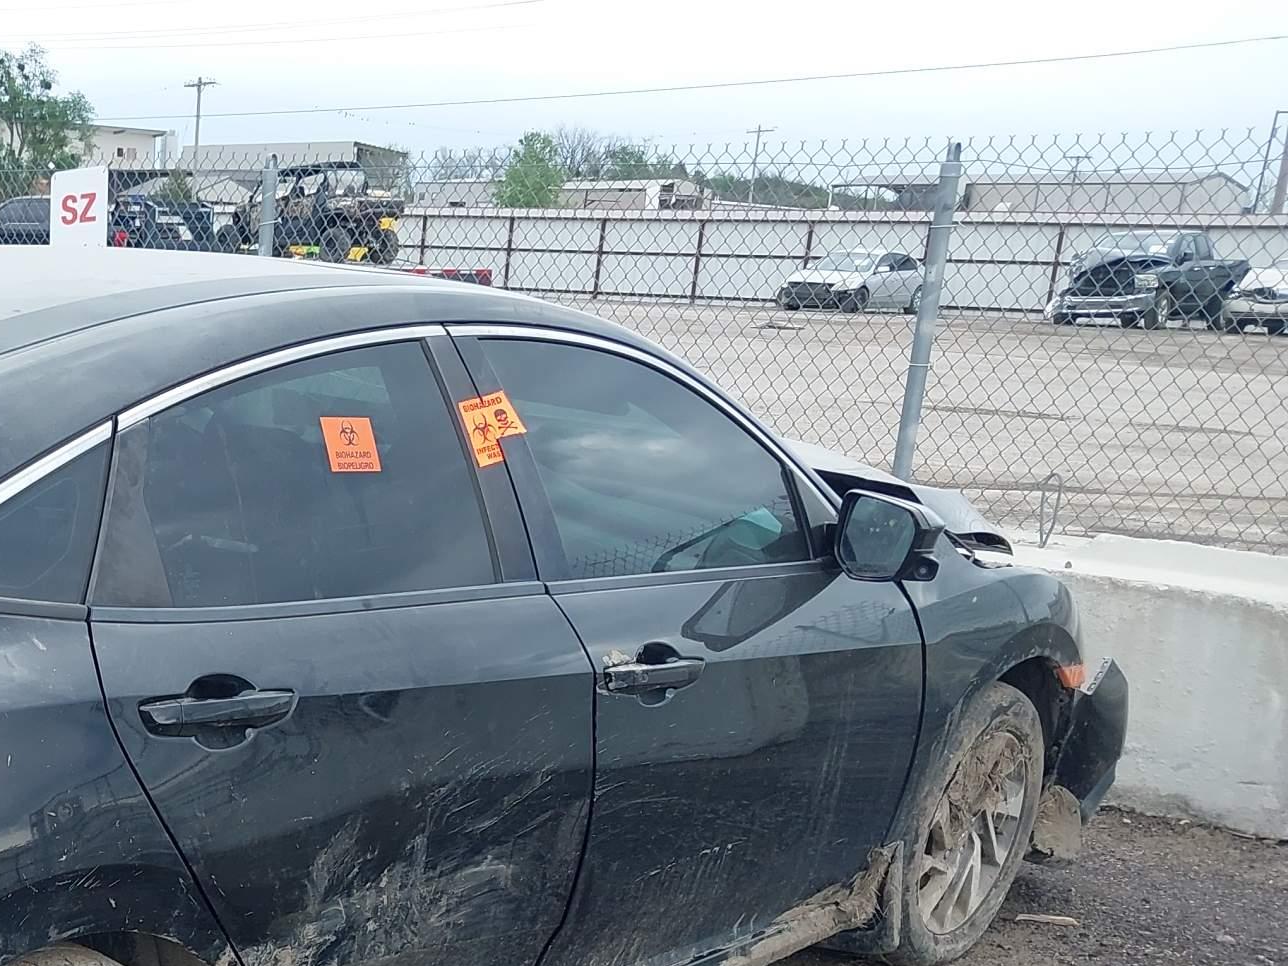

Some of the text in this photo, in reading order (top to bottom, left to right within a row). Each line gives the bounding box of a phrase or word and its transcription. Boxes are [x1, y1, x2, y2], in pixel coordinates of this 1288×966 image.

[61, 192, 97, 225] SZ
[462, 396, 503, 412] BIOHAZARD
[335, 450, 372, 459] BIOHAZARD
